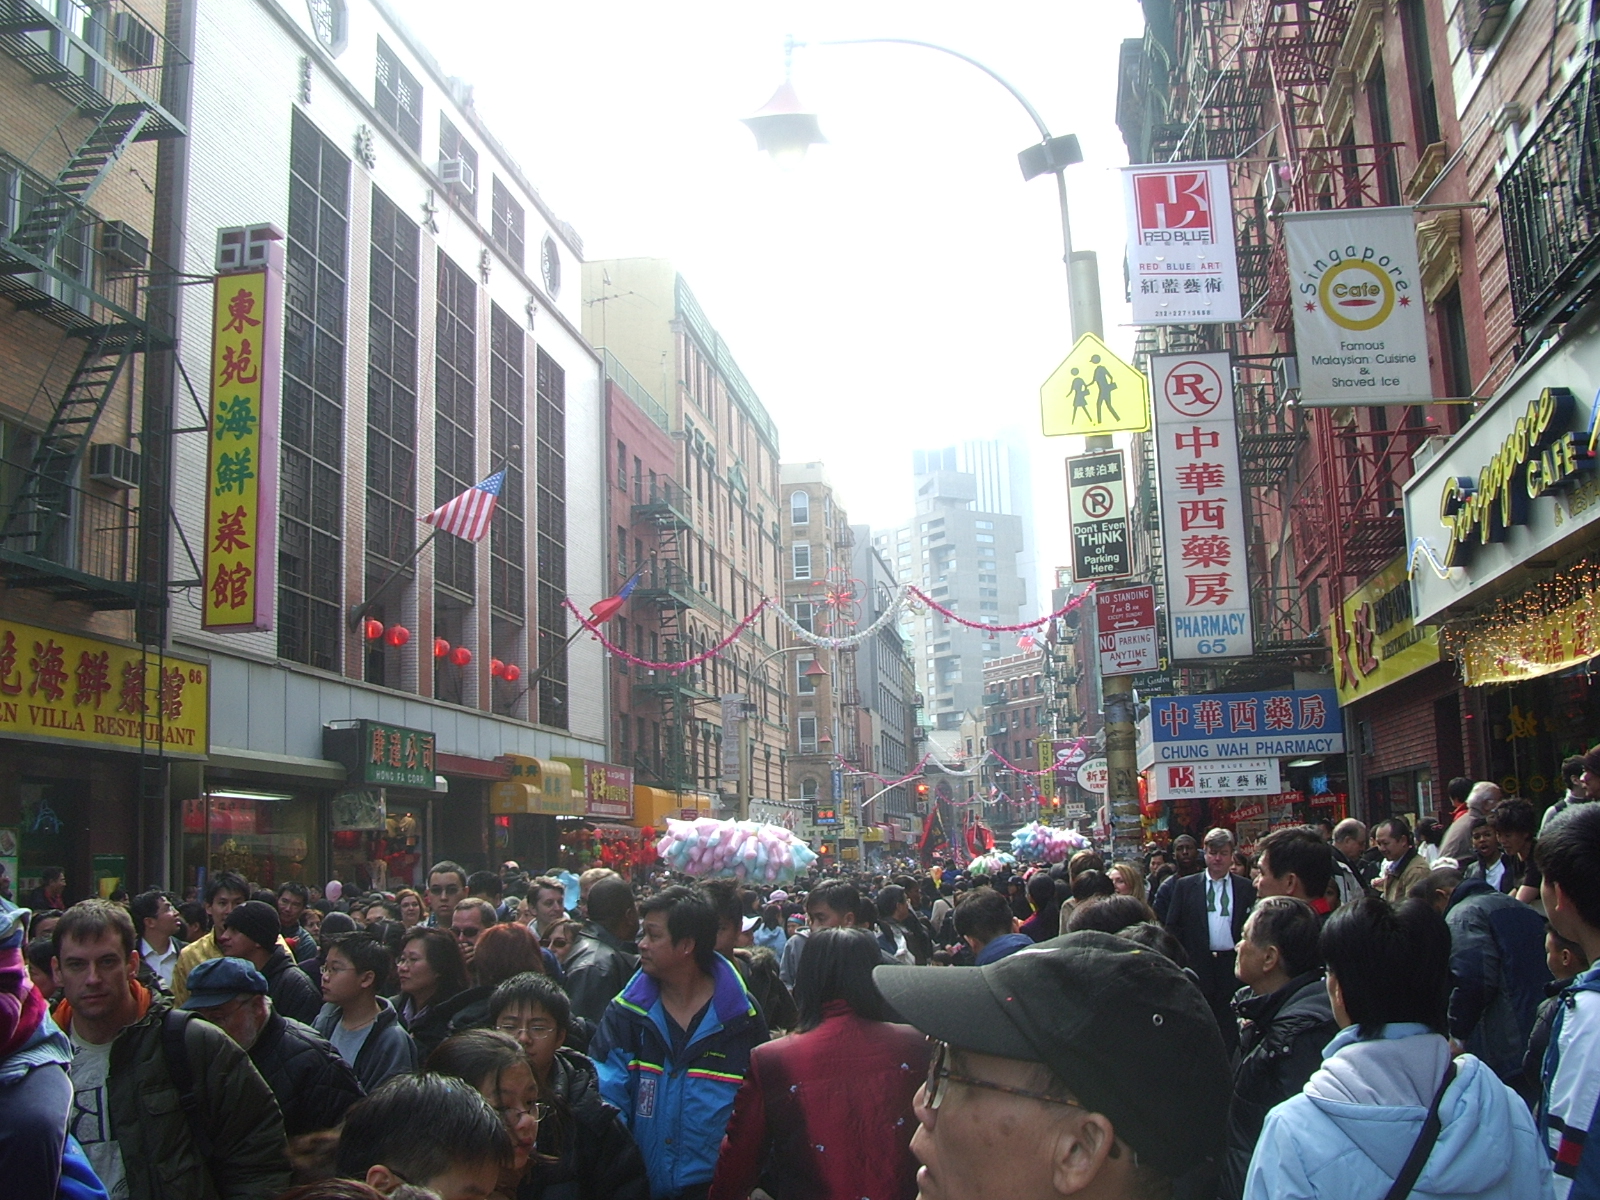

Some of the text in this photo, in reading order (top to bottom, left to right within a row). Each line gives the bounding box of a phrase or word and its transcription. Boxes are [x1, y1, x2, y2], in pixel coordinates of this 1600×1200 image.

[1144, 230, 1209, 242] RED BLUE
[216, 224, 283, 270] 66
[1139, 261, 1221, 271] RED BLUE ART
[1299, 245, 1409, 298] Singapore
[1332, 282, 1381, 299] Cafe
[1340, 341, 1385, 351] Famous
[1311, 354, 1417, 367] Malaysian Cuisine
[1359, 366, 1370, 376] &
[1331, 376, 1401, 388] Shaved Ice
[210, 287, 262, 611] 東苑海鮮菜館
[1526, 431, 1578, 499] CAFE
[1174, 425, 1235, 607] 中華西藥房
[1074, 521, 1126, 535] Don't Even
[1078, 530, 1123, 547] THINK
[1095, 545, 1106, 555] of
[1084, 554, 1120, 565] Parking
[1091, 563, 1114, 574] Here
[1100, 589, 1149, 604] NO STANDING
[1107, 613, 1124, 621] EXCEPT
[1174, 613, 1246, 639] PHARMACY
[1100, 633, 1151, 651] NO PARKING
[1196, 639, 1228, 655] 65
[1109, 648, 1148, 661] ANYTIME
[188, 668, 203, 685] 66
[1160, 693, 1327, 737] 中華西藥房
[28, 704, 86, 732] VILLA
[94, 714, 196, 746] RESTAURANT
[1161, 738, 1333, 760] CHUNG WAH PHARMACY
[375, 770, 394, 781] HONG
